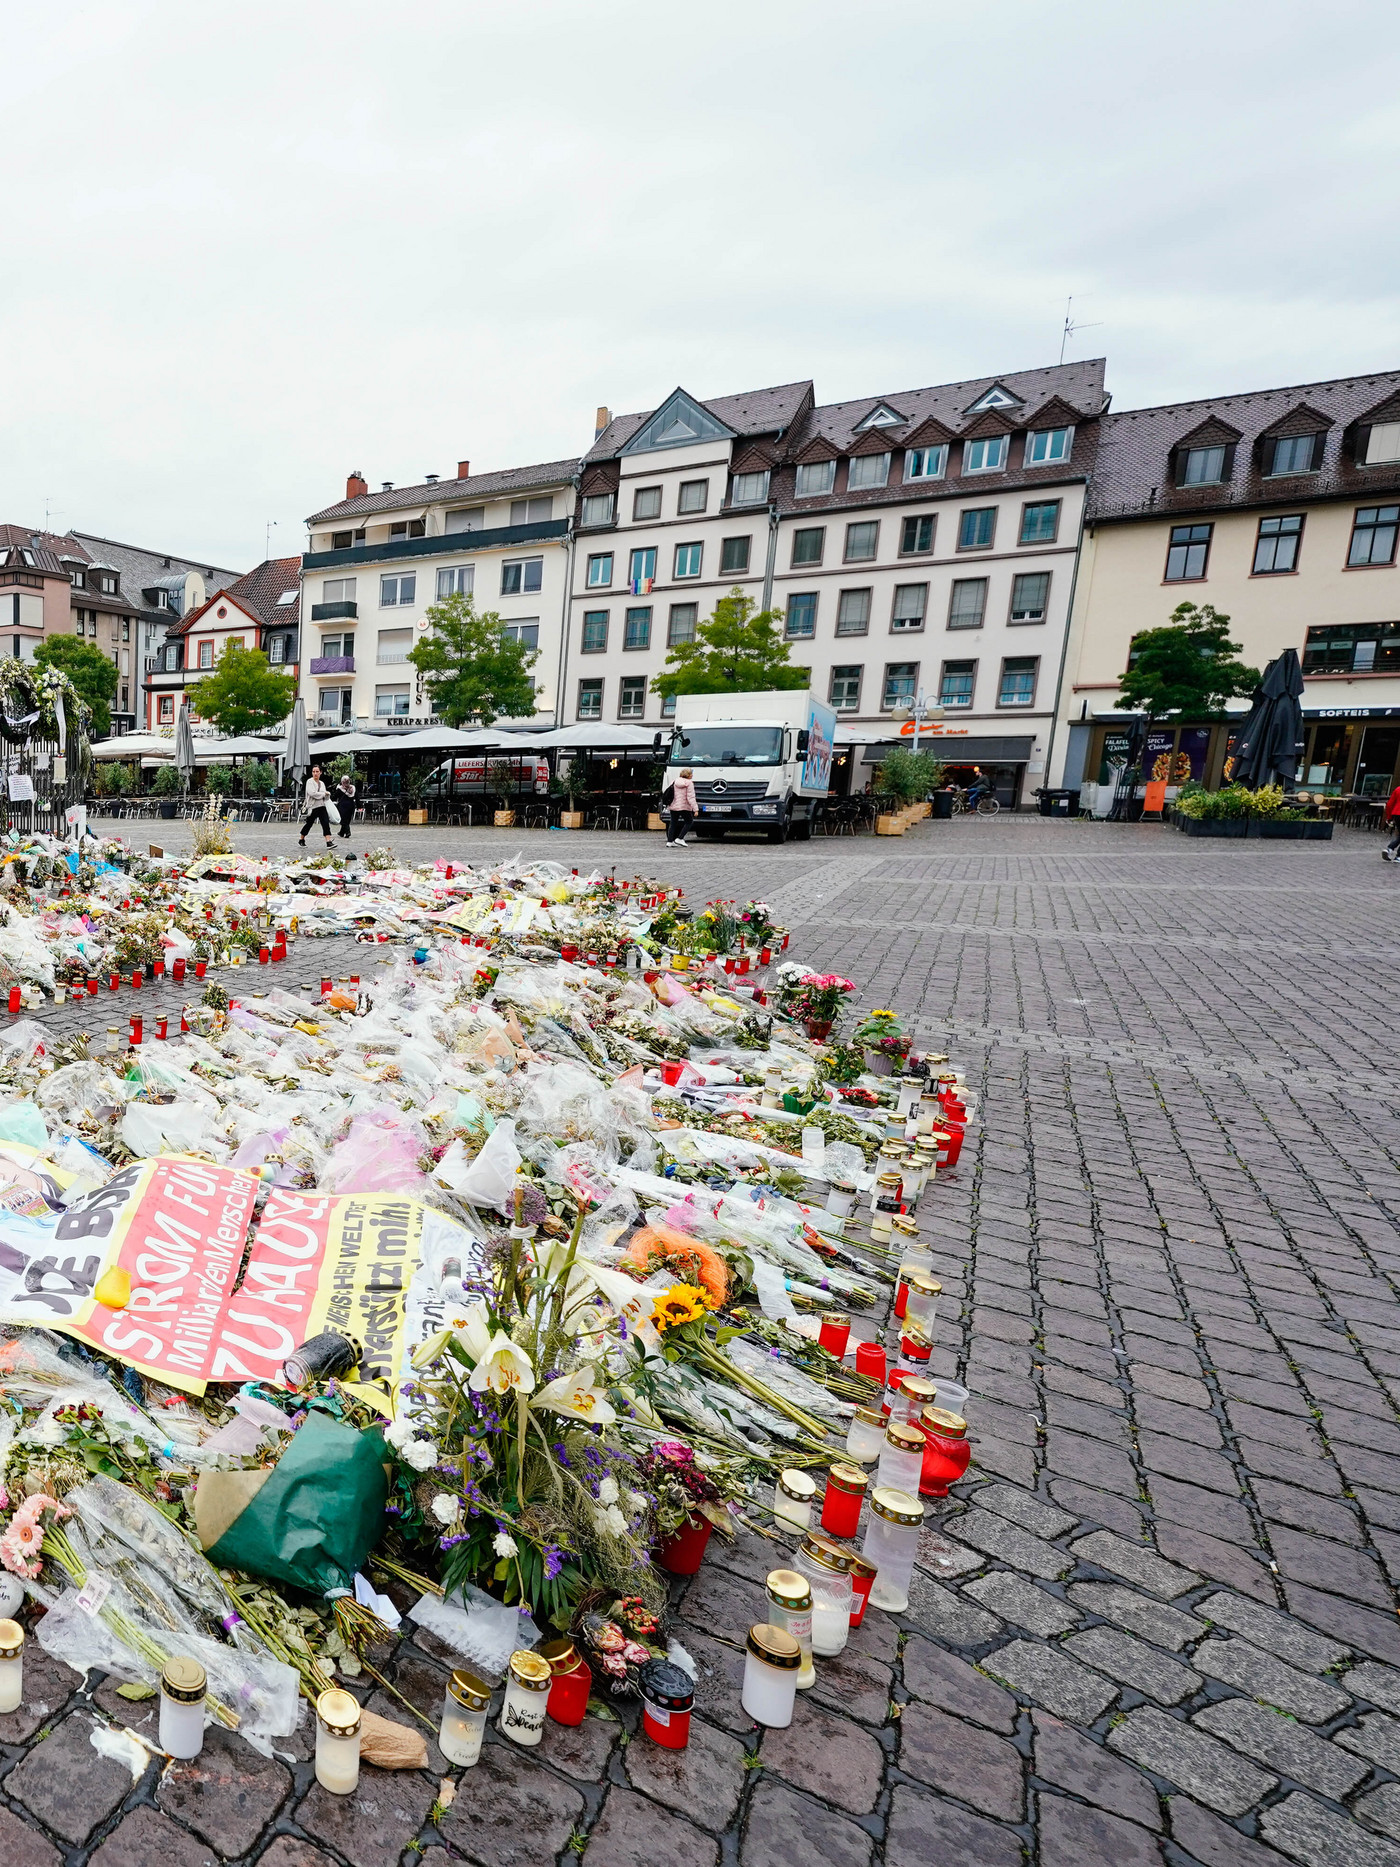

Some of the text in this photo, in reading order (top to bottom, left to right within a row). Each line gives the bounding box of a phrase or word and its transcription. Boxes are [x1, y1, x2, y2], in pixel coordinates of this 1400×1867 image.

[1319, 709, 1370, 717] SOFTEIS
[387, 718, 414, 726] KEBAP
[1147, 743, 1174, 751] Chicago
[11, 1254, 101, 1315] JOE
[103, 1211, 202, 1360] STROM
